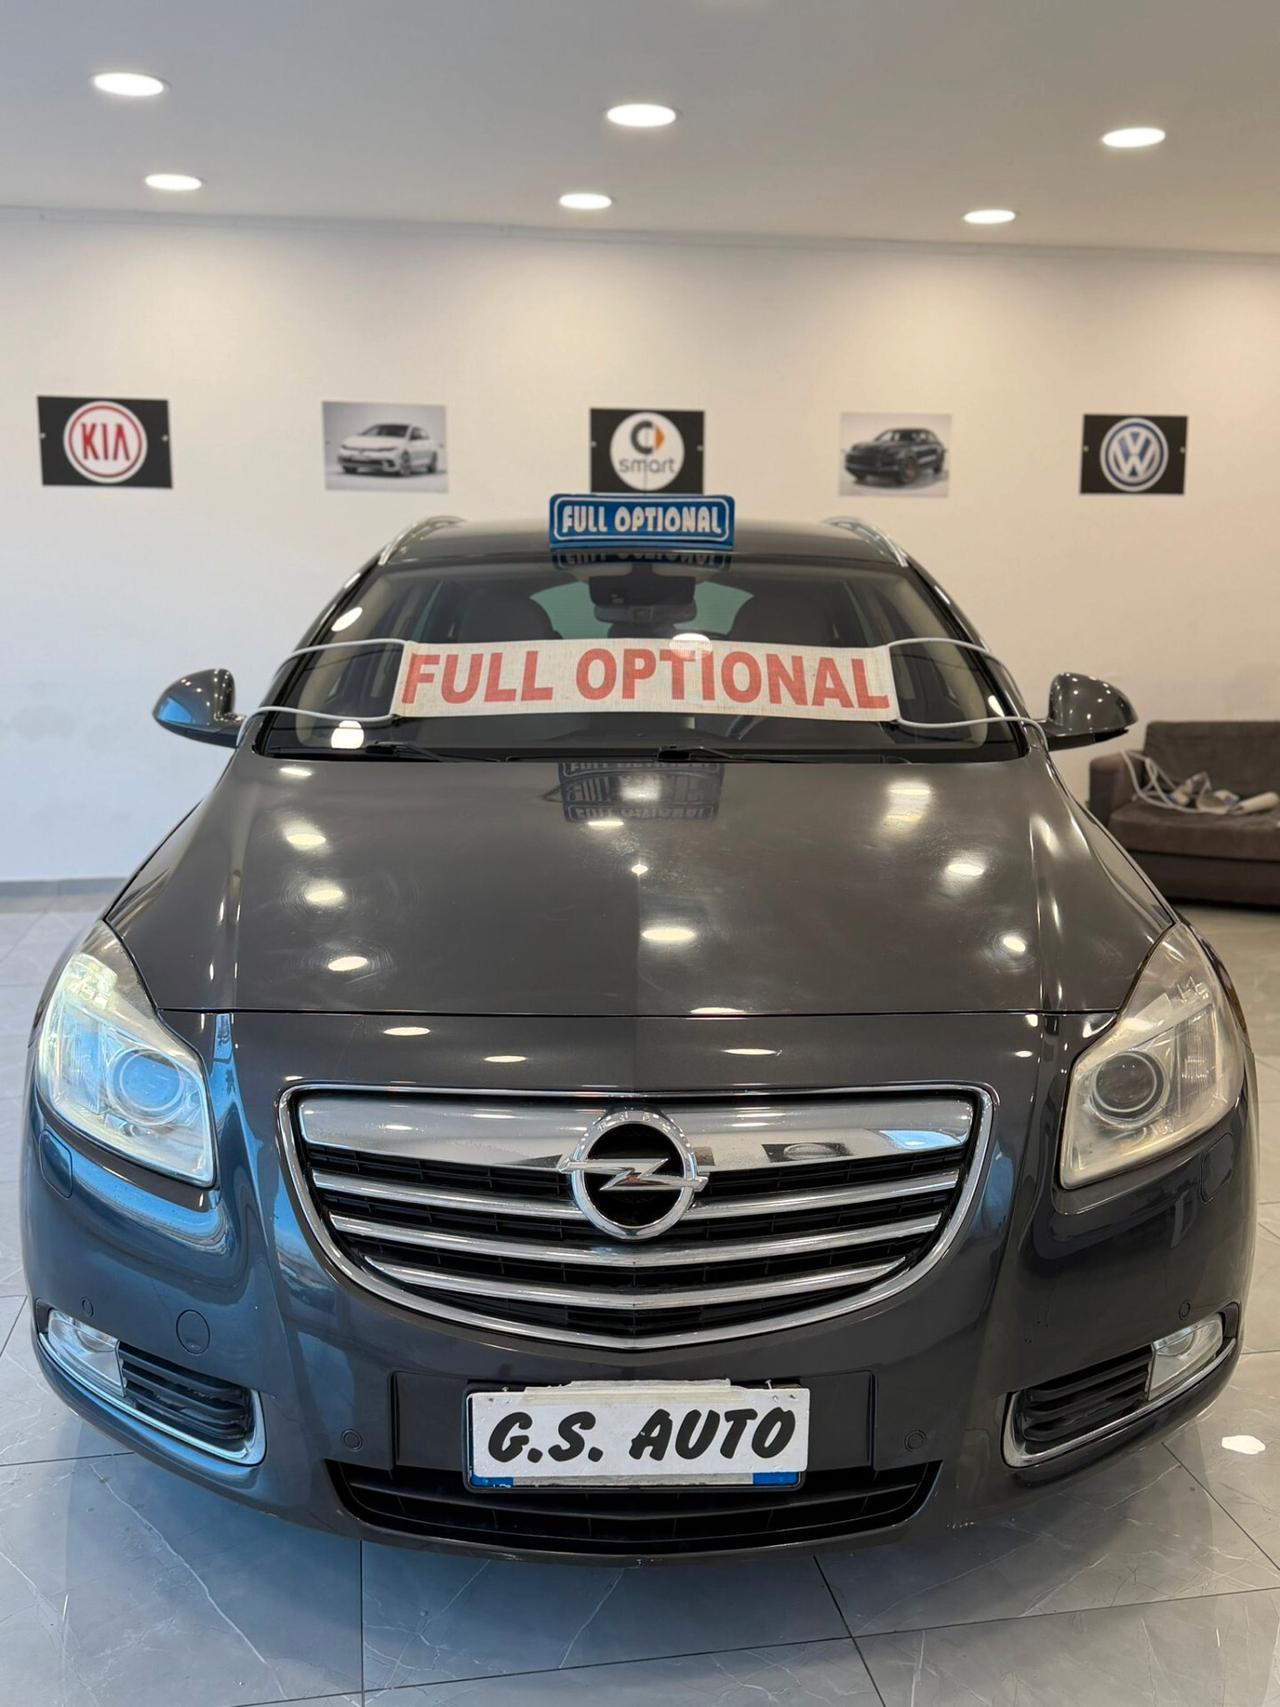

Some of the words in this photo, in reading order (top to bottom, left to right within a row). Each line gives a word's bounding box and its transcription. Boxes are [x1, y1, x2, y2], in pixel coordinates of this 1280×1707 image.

[81, 422, 130, 461] KIA
[619, 458, 675, 473] smart
[562, 505, 607, 533] FULL
[614, 506, 722, 534] OPTIONAL
[401, 651, 554, 704] FULL
[576, 648, 890, 709] OPTIONAL
[488, 1411, 604, 1463] G.S.
[628, 1407, 797, 1461] AUTO
